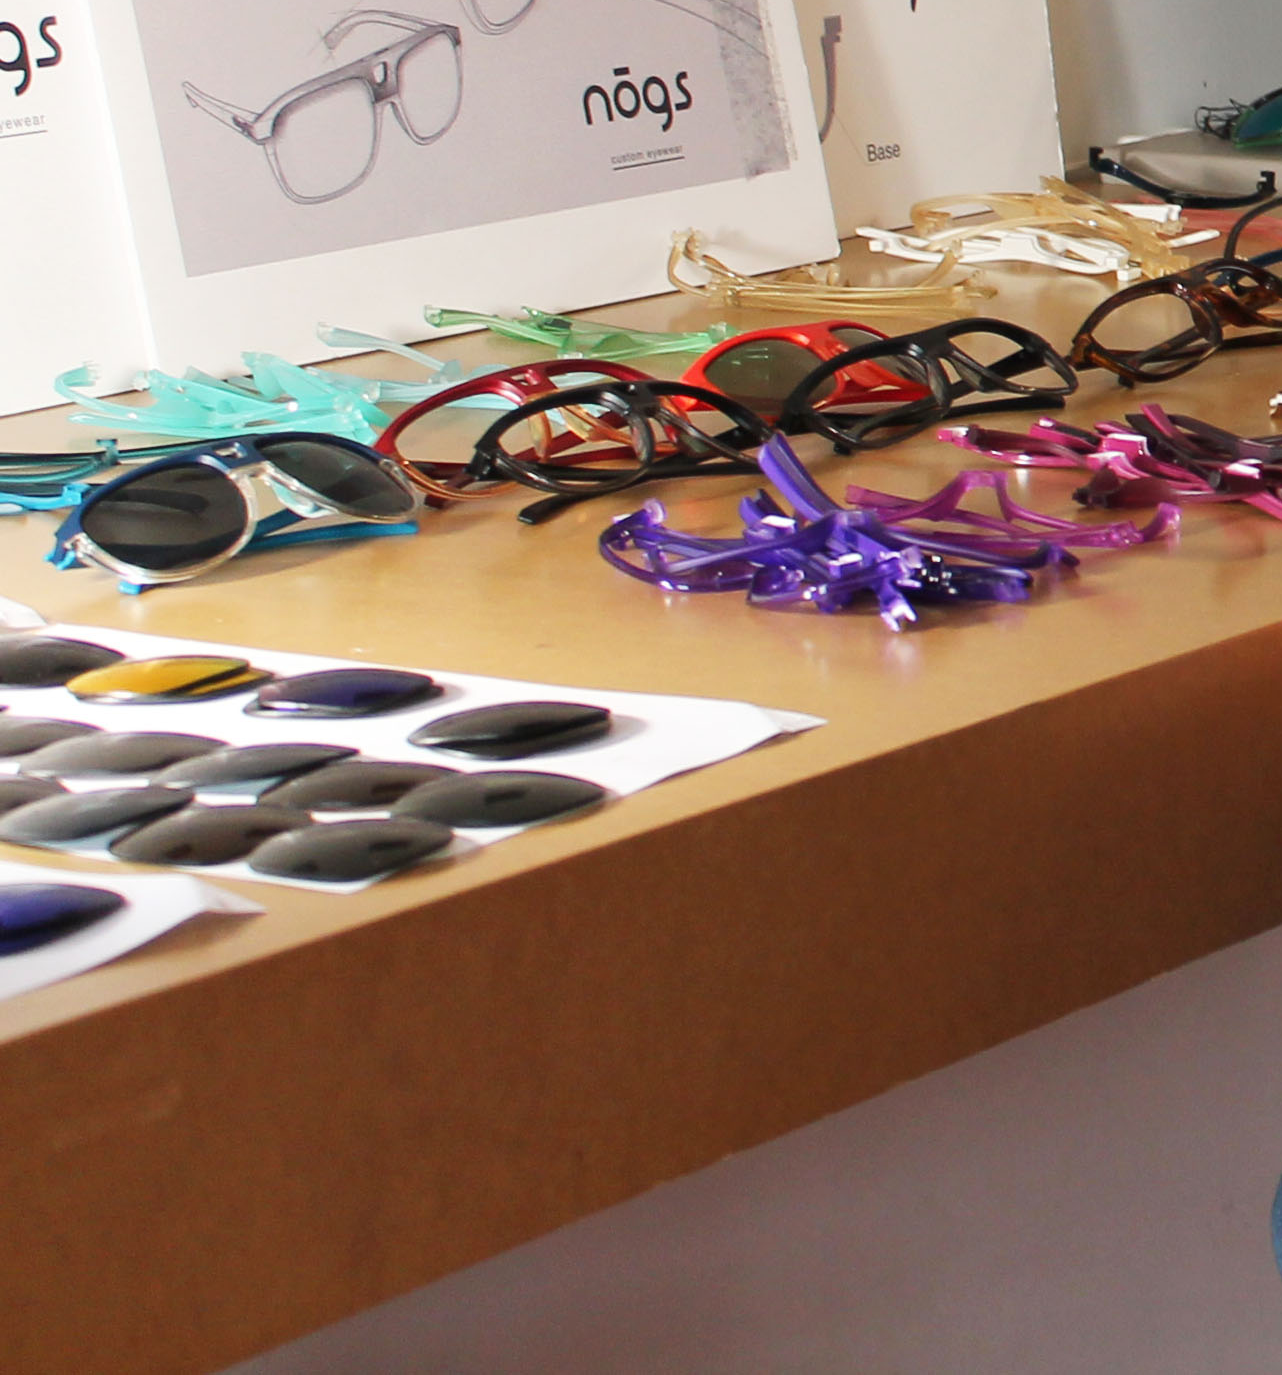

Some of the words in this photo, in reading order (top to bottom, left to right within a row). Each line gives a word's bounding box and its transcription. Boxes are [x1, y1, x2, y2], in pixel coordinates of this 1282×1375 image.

[583, 66, 693, 132] nōgs
[611, 152, 645, 164] custom
[647, 146, 683, 159] eyewear
[866, 143, 901, 162] Base
